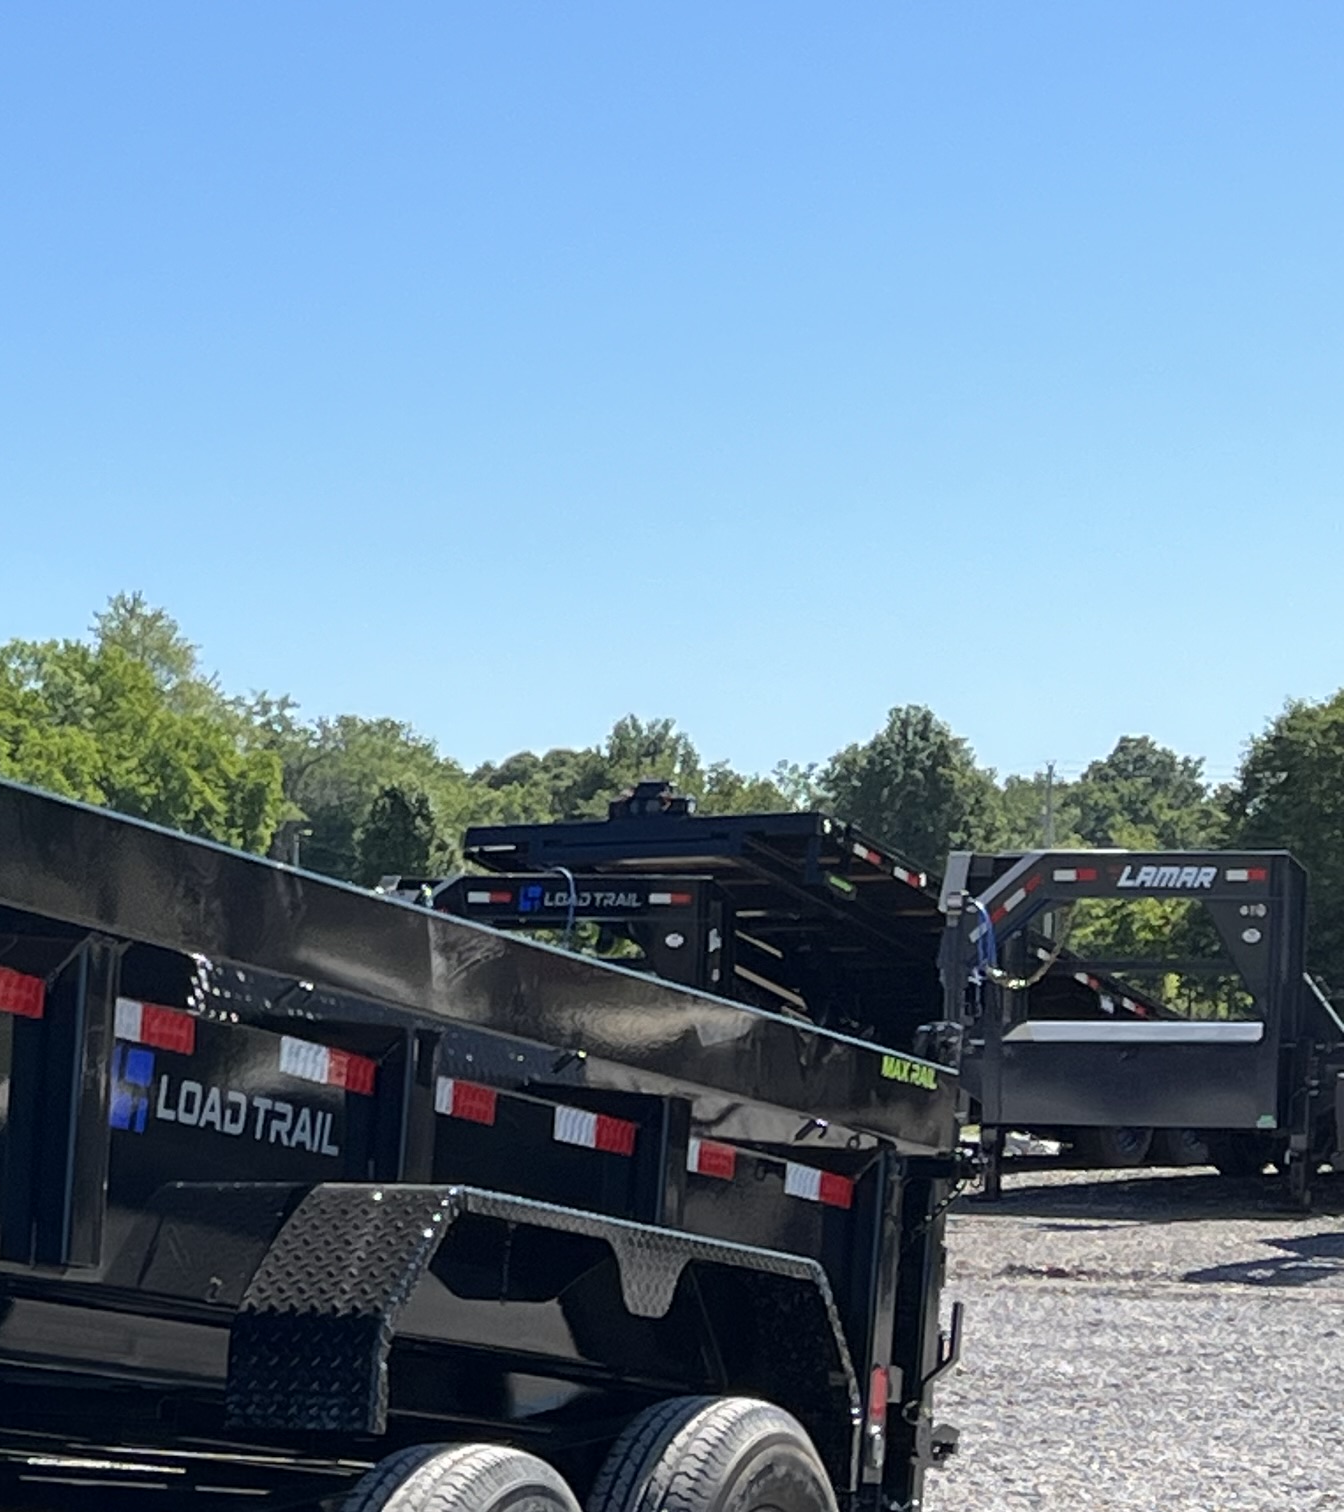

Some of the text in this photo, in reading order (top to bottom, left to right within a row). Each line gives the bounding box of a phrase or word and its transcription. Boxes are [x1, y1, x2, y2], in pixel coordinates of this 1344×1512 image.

[1117, 865, 1217, 889] LAMAR
[593, 892, 642, 908] TRAIL
[156, 1074, 339, 1156] LOAD TRAIL
